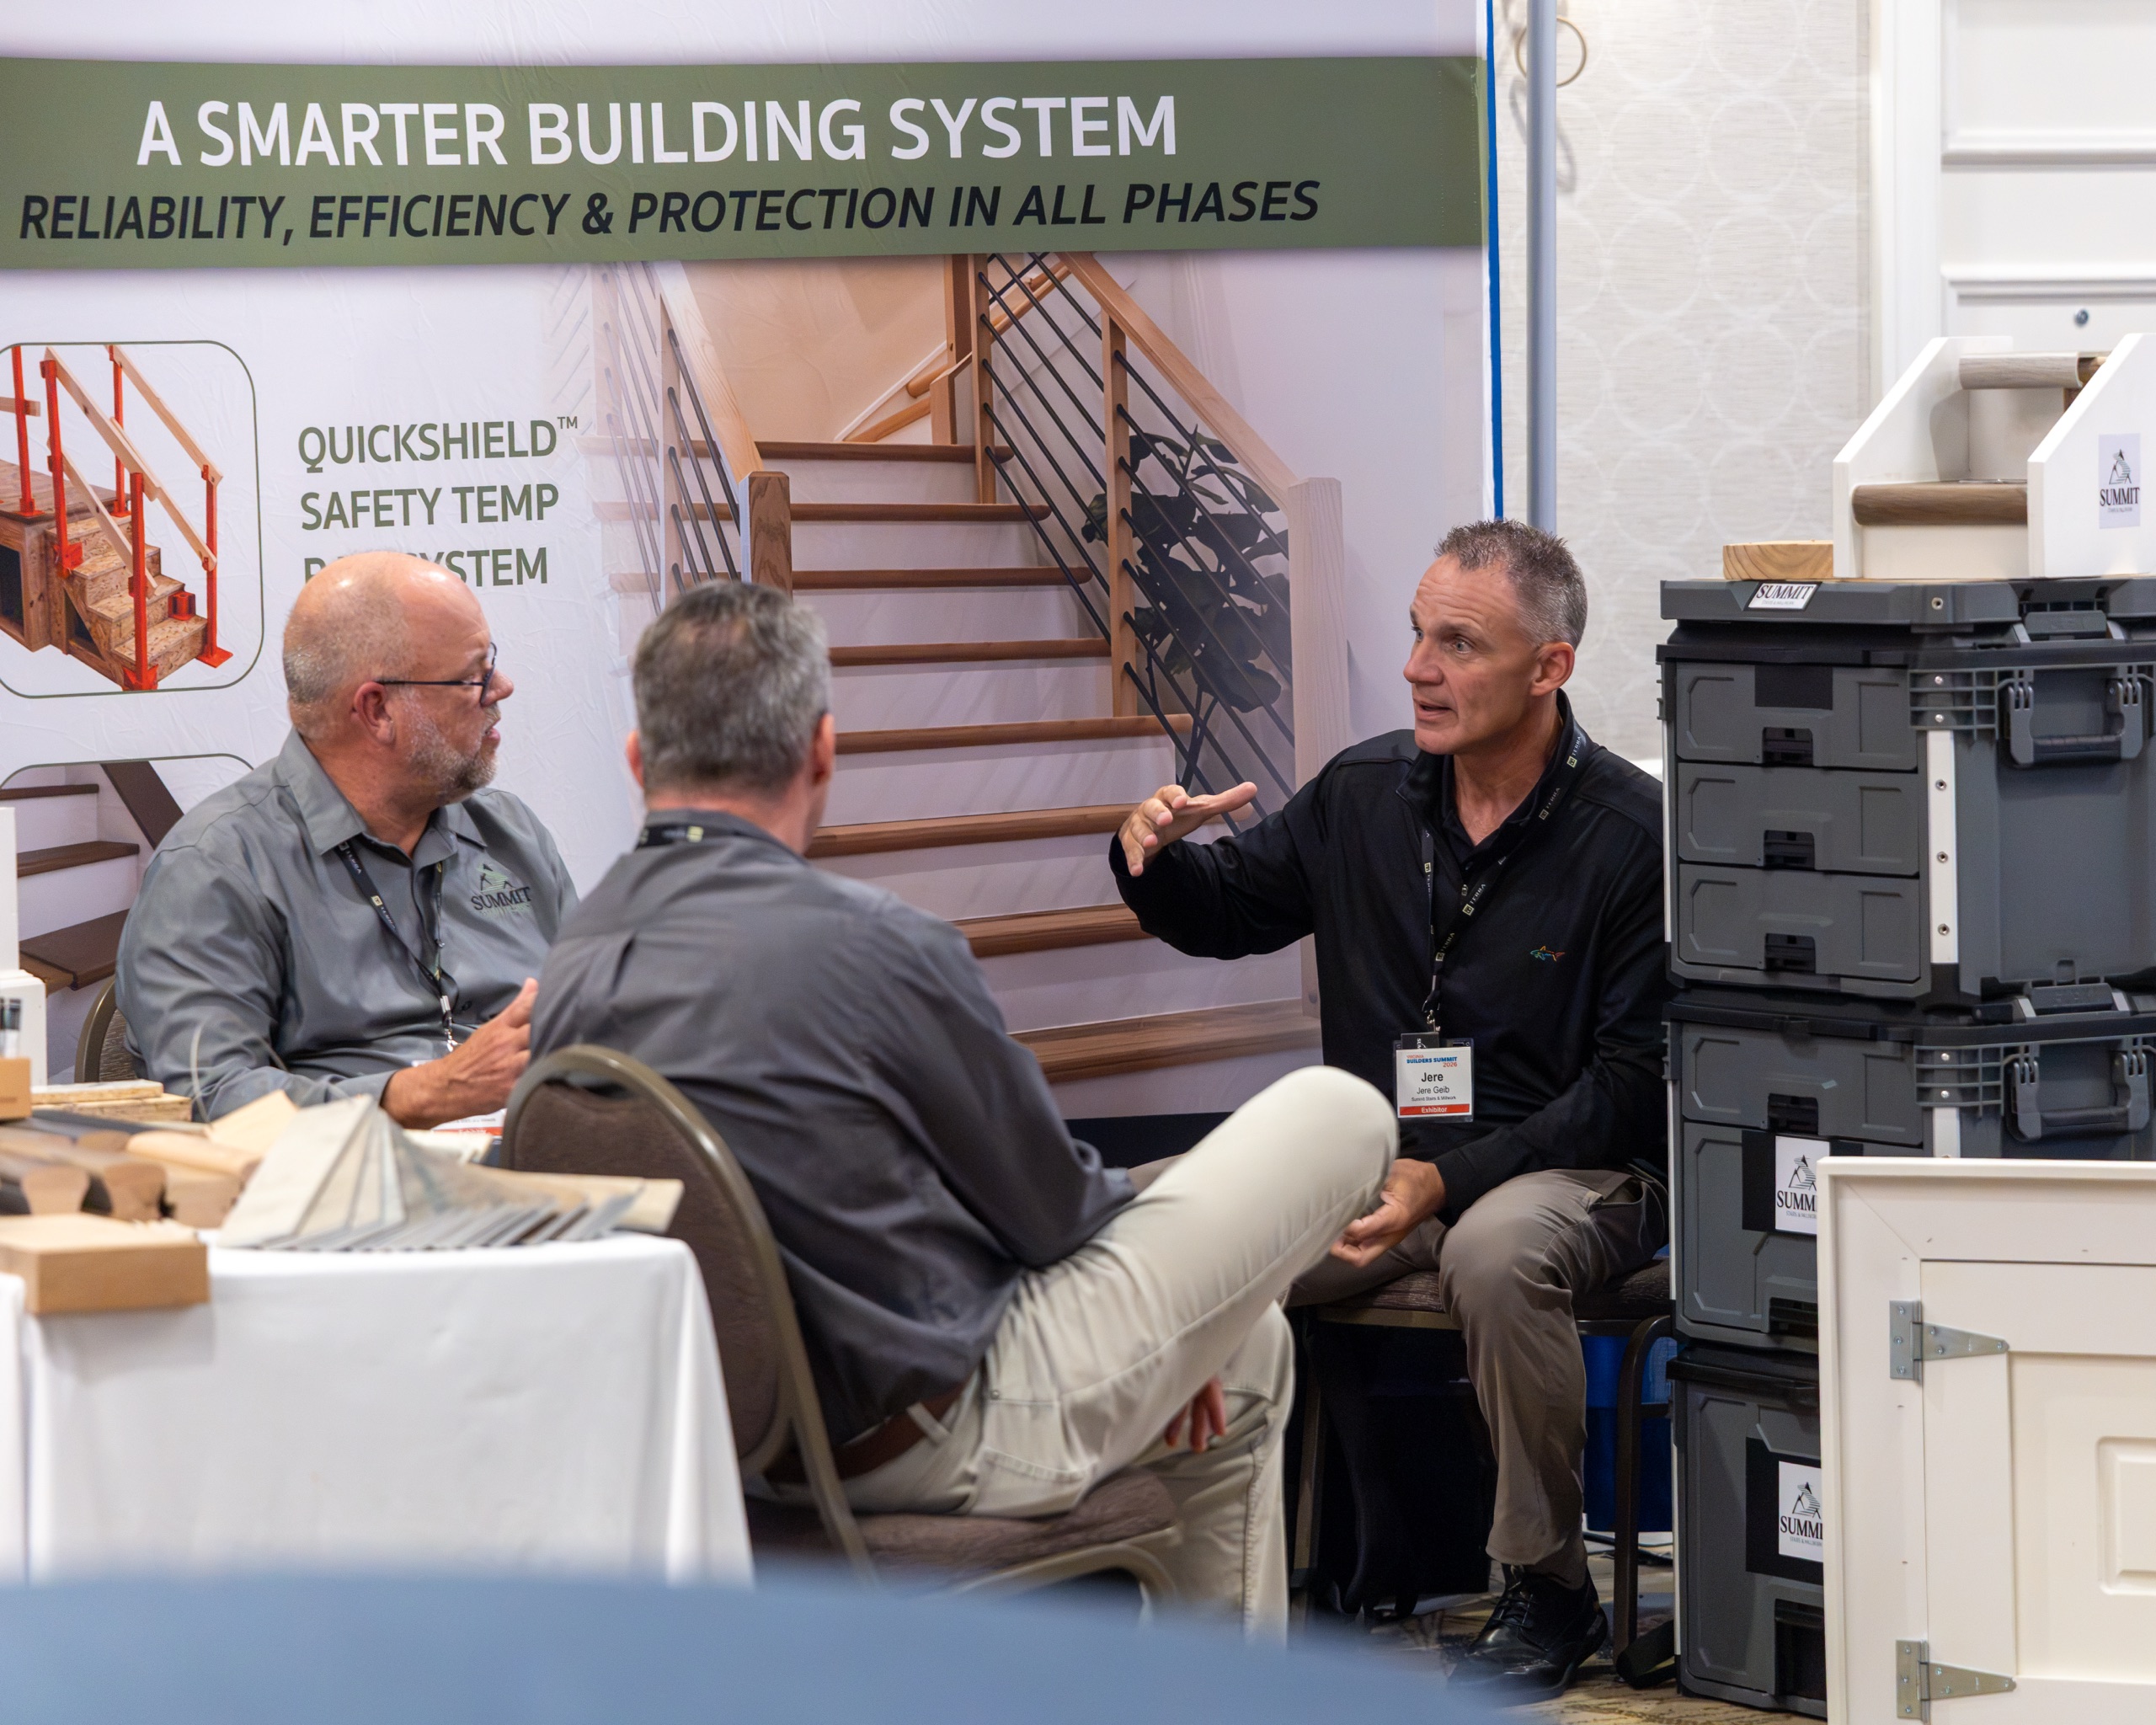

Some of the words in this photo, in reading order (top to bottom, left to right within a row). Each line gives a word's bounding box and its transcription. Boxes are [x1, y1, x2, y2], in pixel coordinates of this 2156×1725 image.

[136, 100, 181, 166] A
[197, 100, 508, 167] SMARTER
[528, 99, 866, 166] BUILDING
[889, 95, 1177, 160] SYSTEM
[19, 195, 294, 246] RELIABILITY,
[309, 193, 571, 239] EFFICIENCY
[581, 192, 614, 235] &
[627, 187, 936, 235] PROTECTION
[948, 186, 1002, 227] IN
[1012, 184, 1107, 226] ALL
[1123, 180, 1321, 223] PHASES
[301, 487, 443, 531] SAFETY
[451, 483, 559, 524] TEMP
[2100, 487, 2140, 506] SUMMIT
[410, 547, 547, 587] STEM
[1756, 585, 1813, 599] SUMMIT
[471, 886, 531, 911] SUMMIT
[1421, 1072, 1444, 1082] Jere
[1433, 1086, 1450, 1094] Geib
[1776, 1190, 1817, 1212] SUMM
[1780, 1515, 1822, 1540] SUMMI
